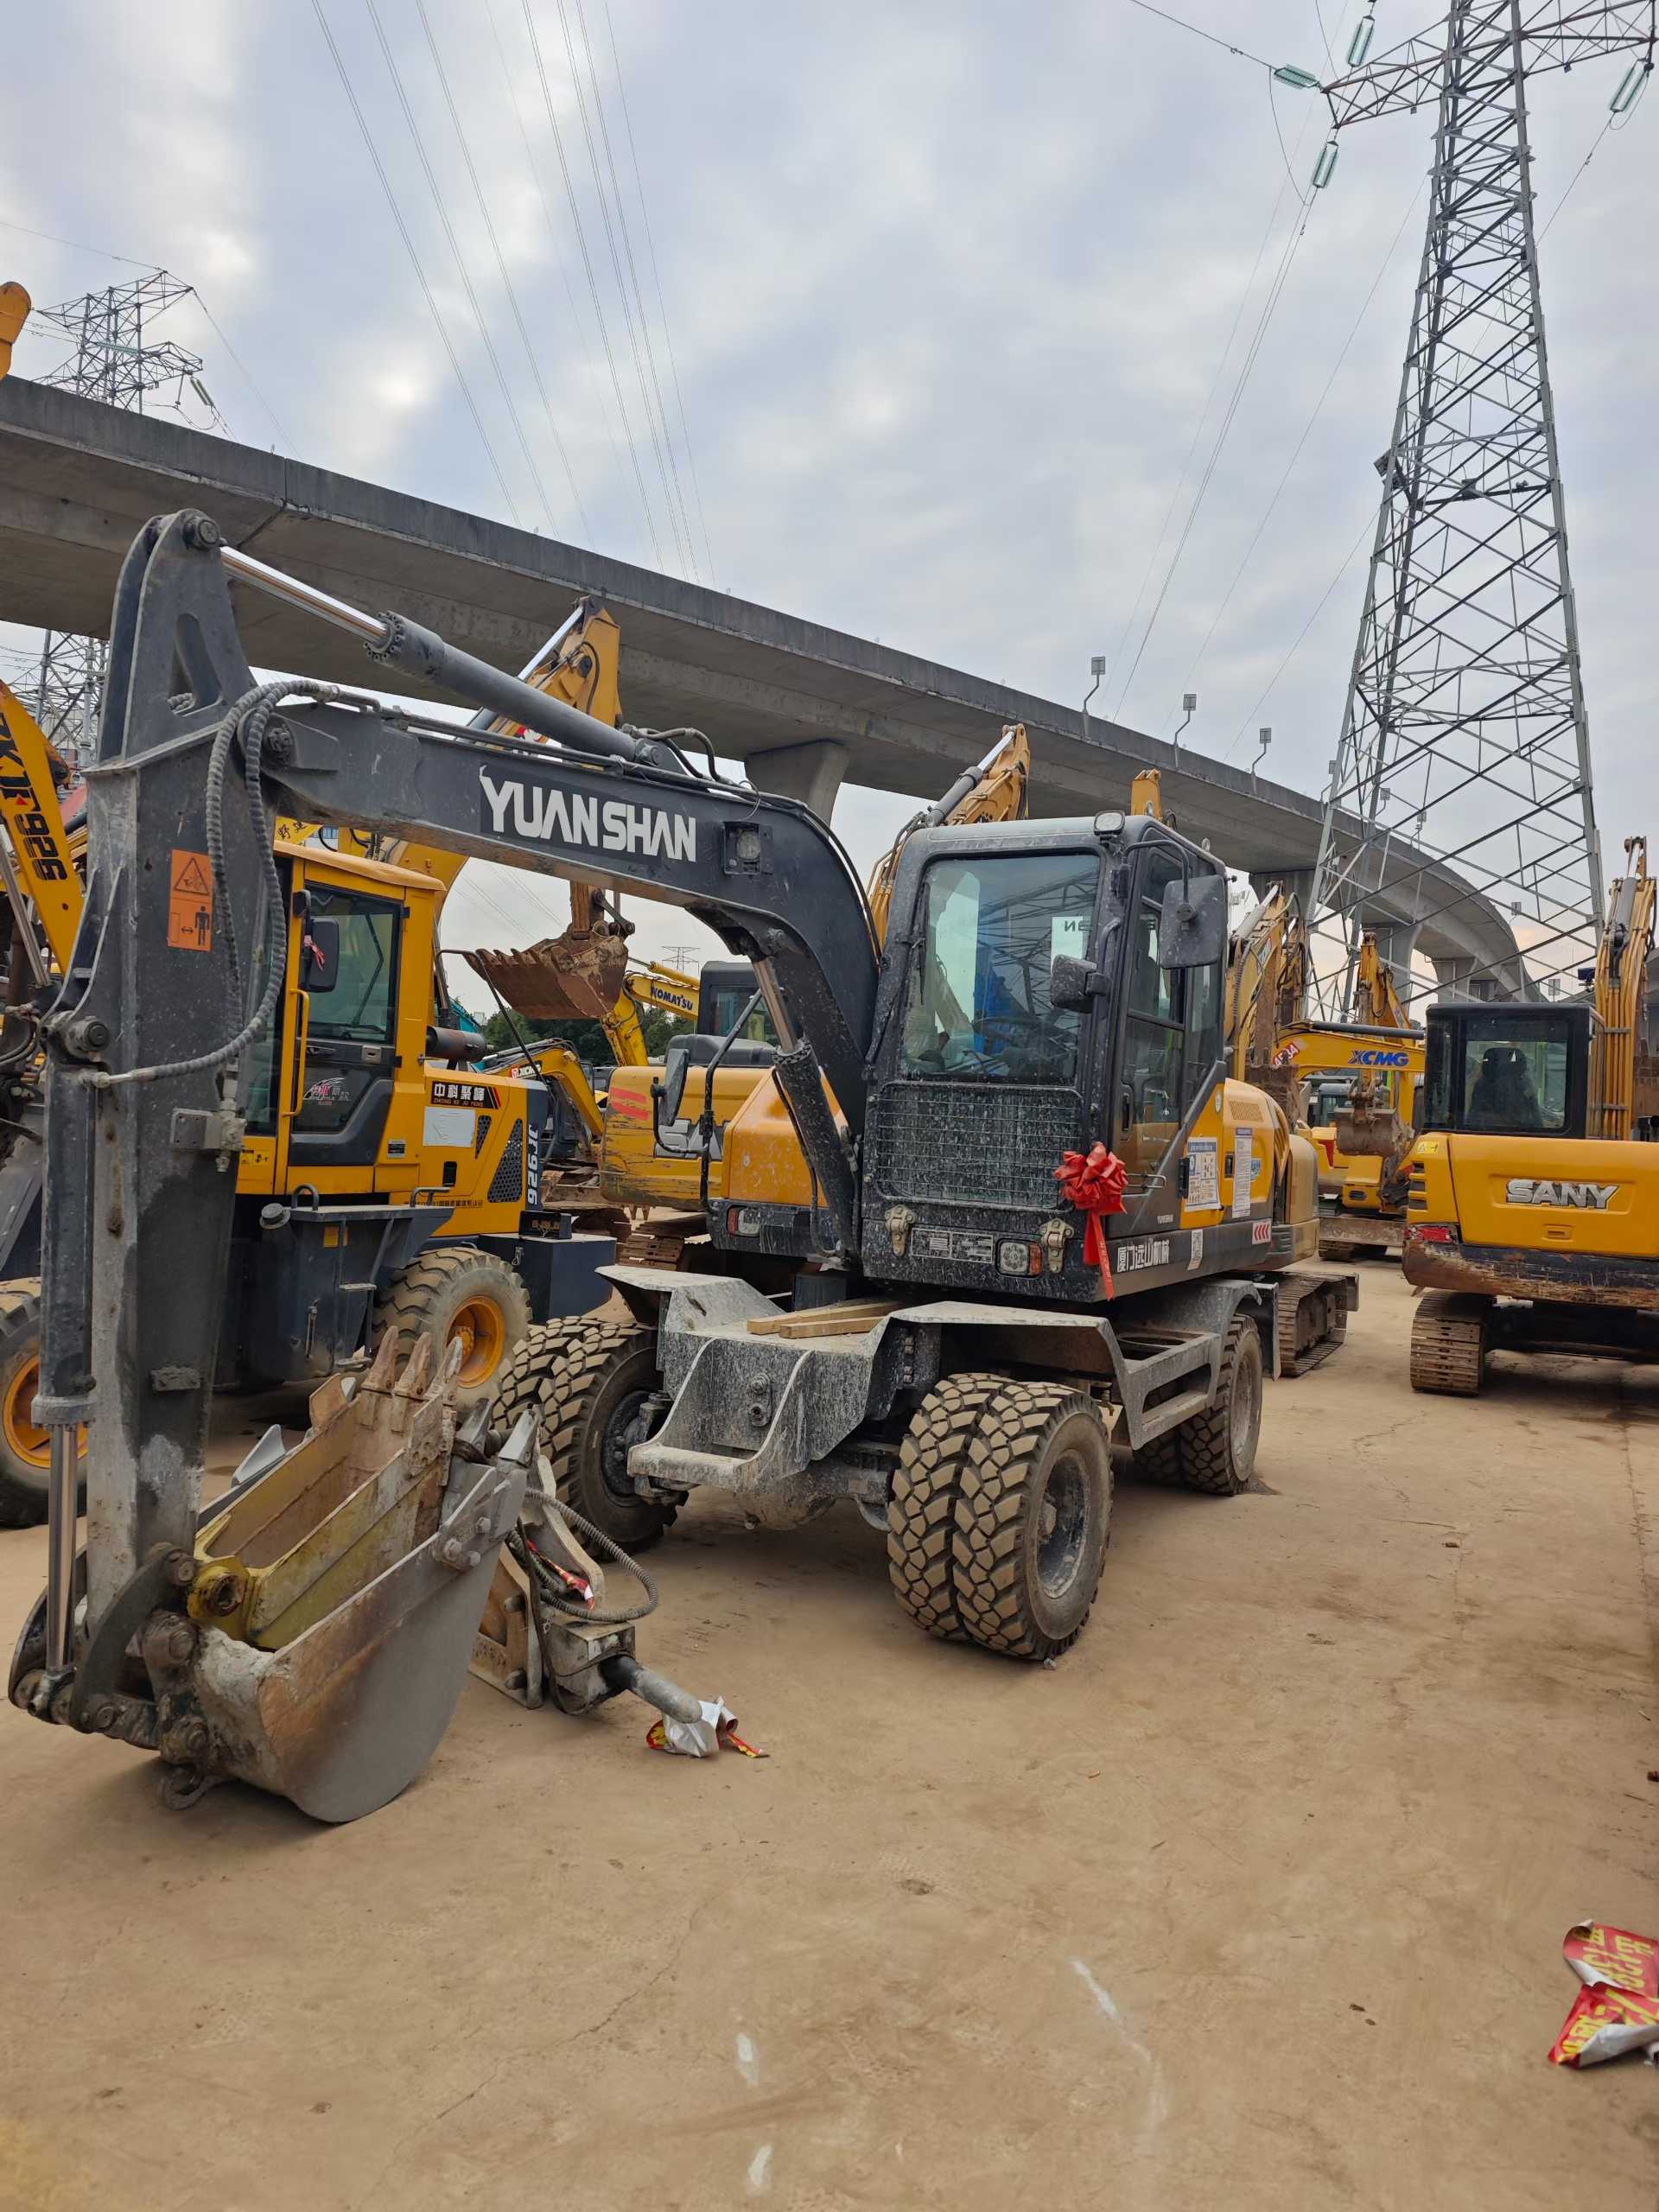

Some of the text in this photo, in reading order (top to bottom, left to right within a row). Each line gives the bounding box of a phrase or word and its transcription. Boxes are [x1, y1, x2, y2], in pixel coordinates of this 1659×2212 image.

[479, 769, 696, 862] YUANSHAN
[651, 987, 693, 1010] KOMATSU
[1348, 1050, 1409, 1067] XCMG
[527, 1123, 538, 1205] JF926
[1506, 1178, 1619, 1209] SANY
